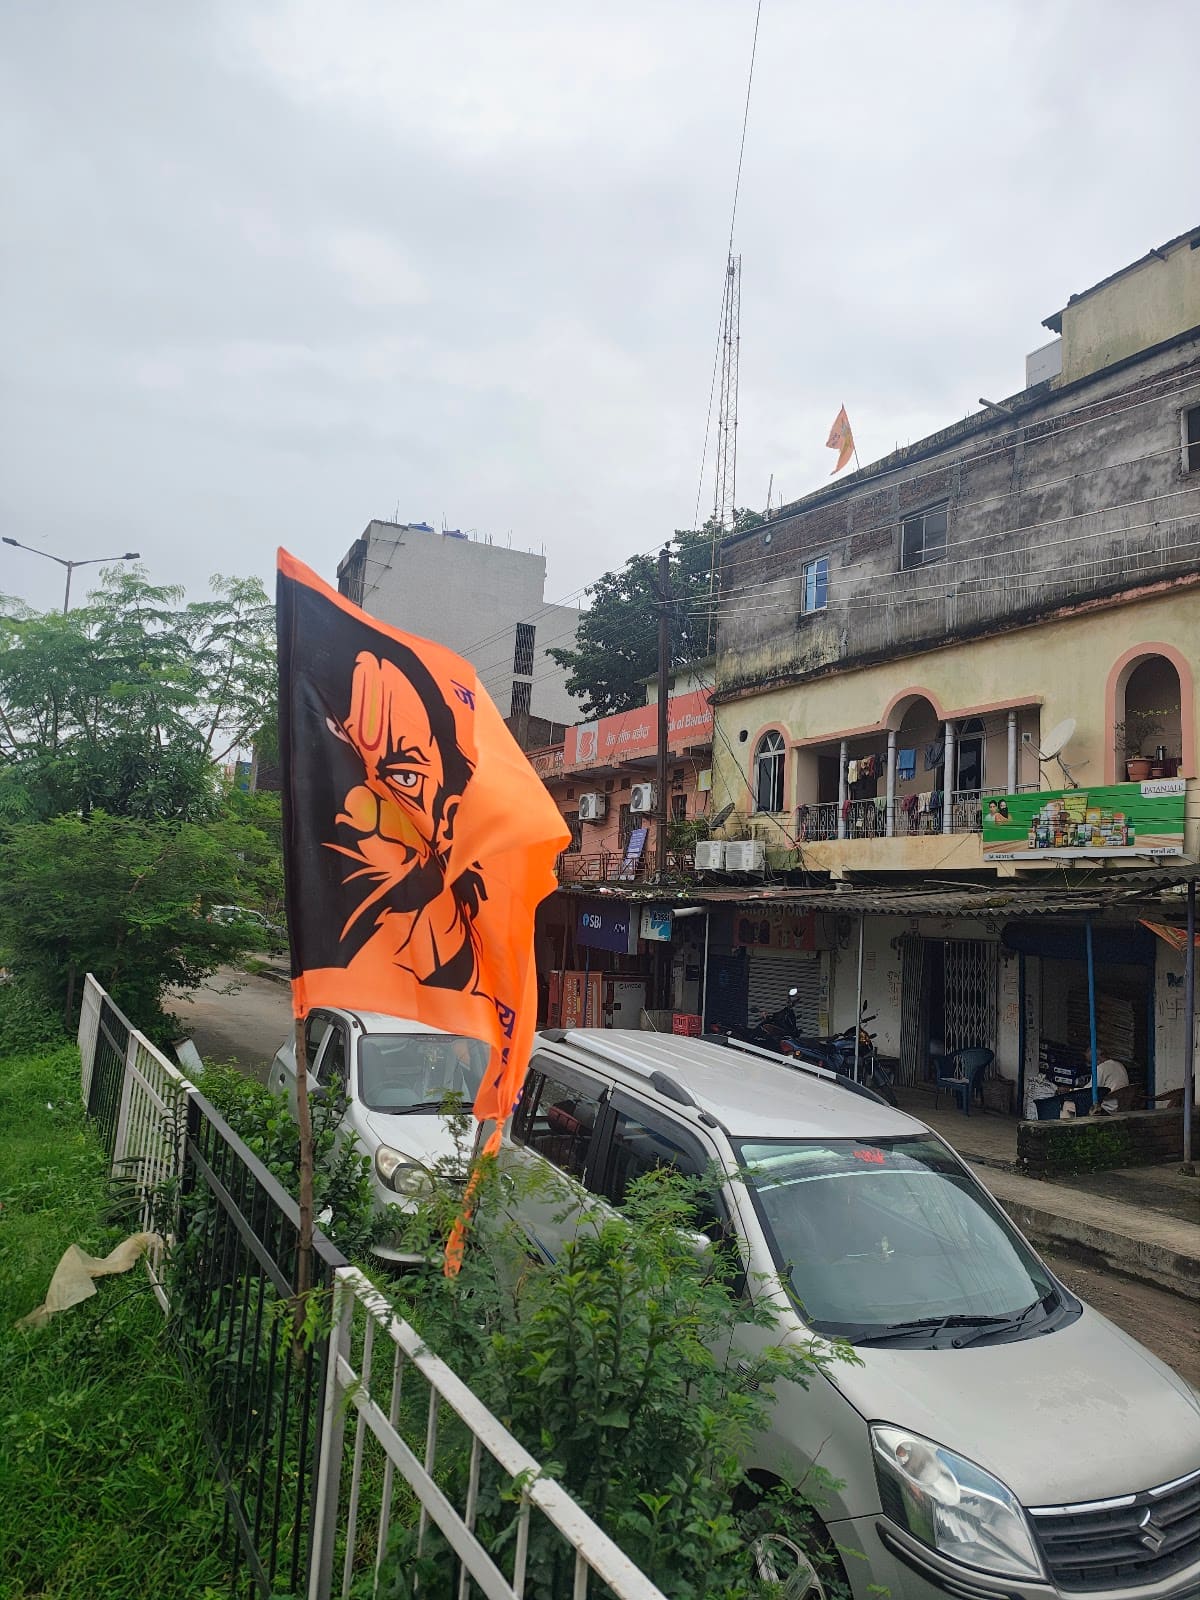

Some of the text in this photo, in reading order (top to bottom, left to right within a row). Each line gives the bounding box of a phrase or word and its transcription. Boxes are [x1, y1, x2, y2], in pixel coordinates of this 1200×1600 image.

[1144, 784, 1182, 793] PATANJALI
[590, 914, 602, 929] SBI
[613, 923, 626, 934] ATM
